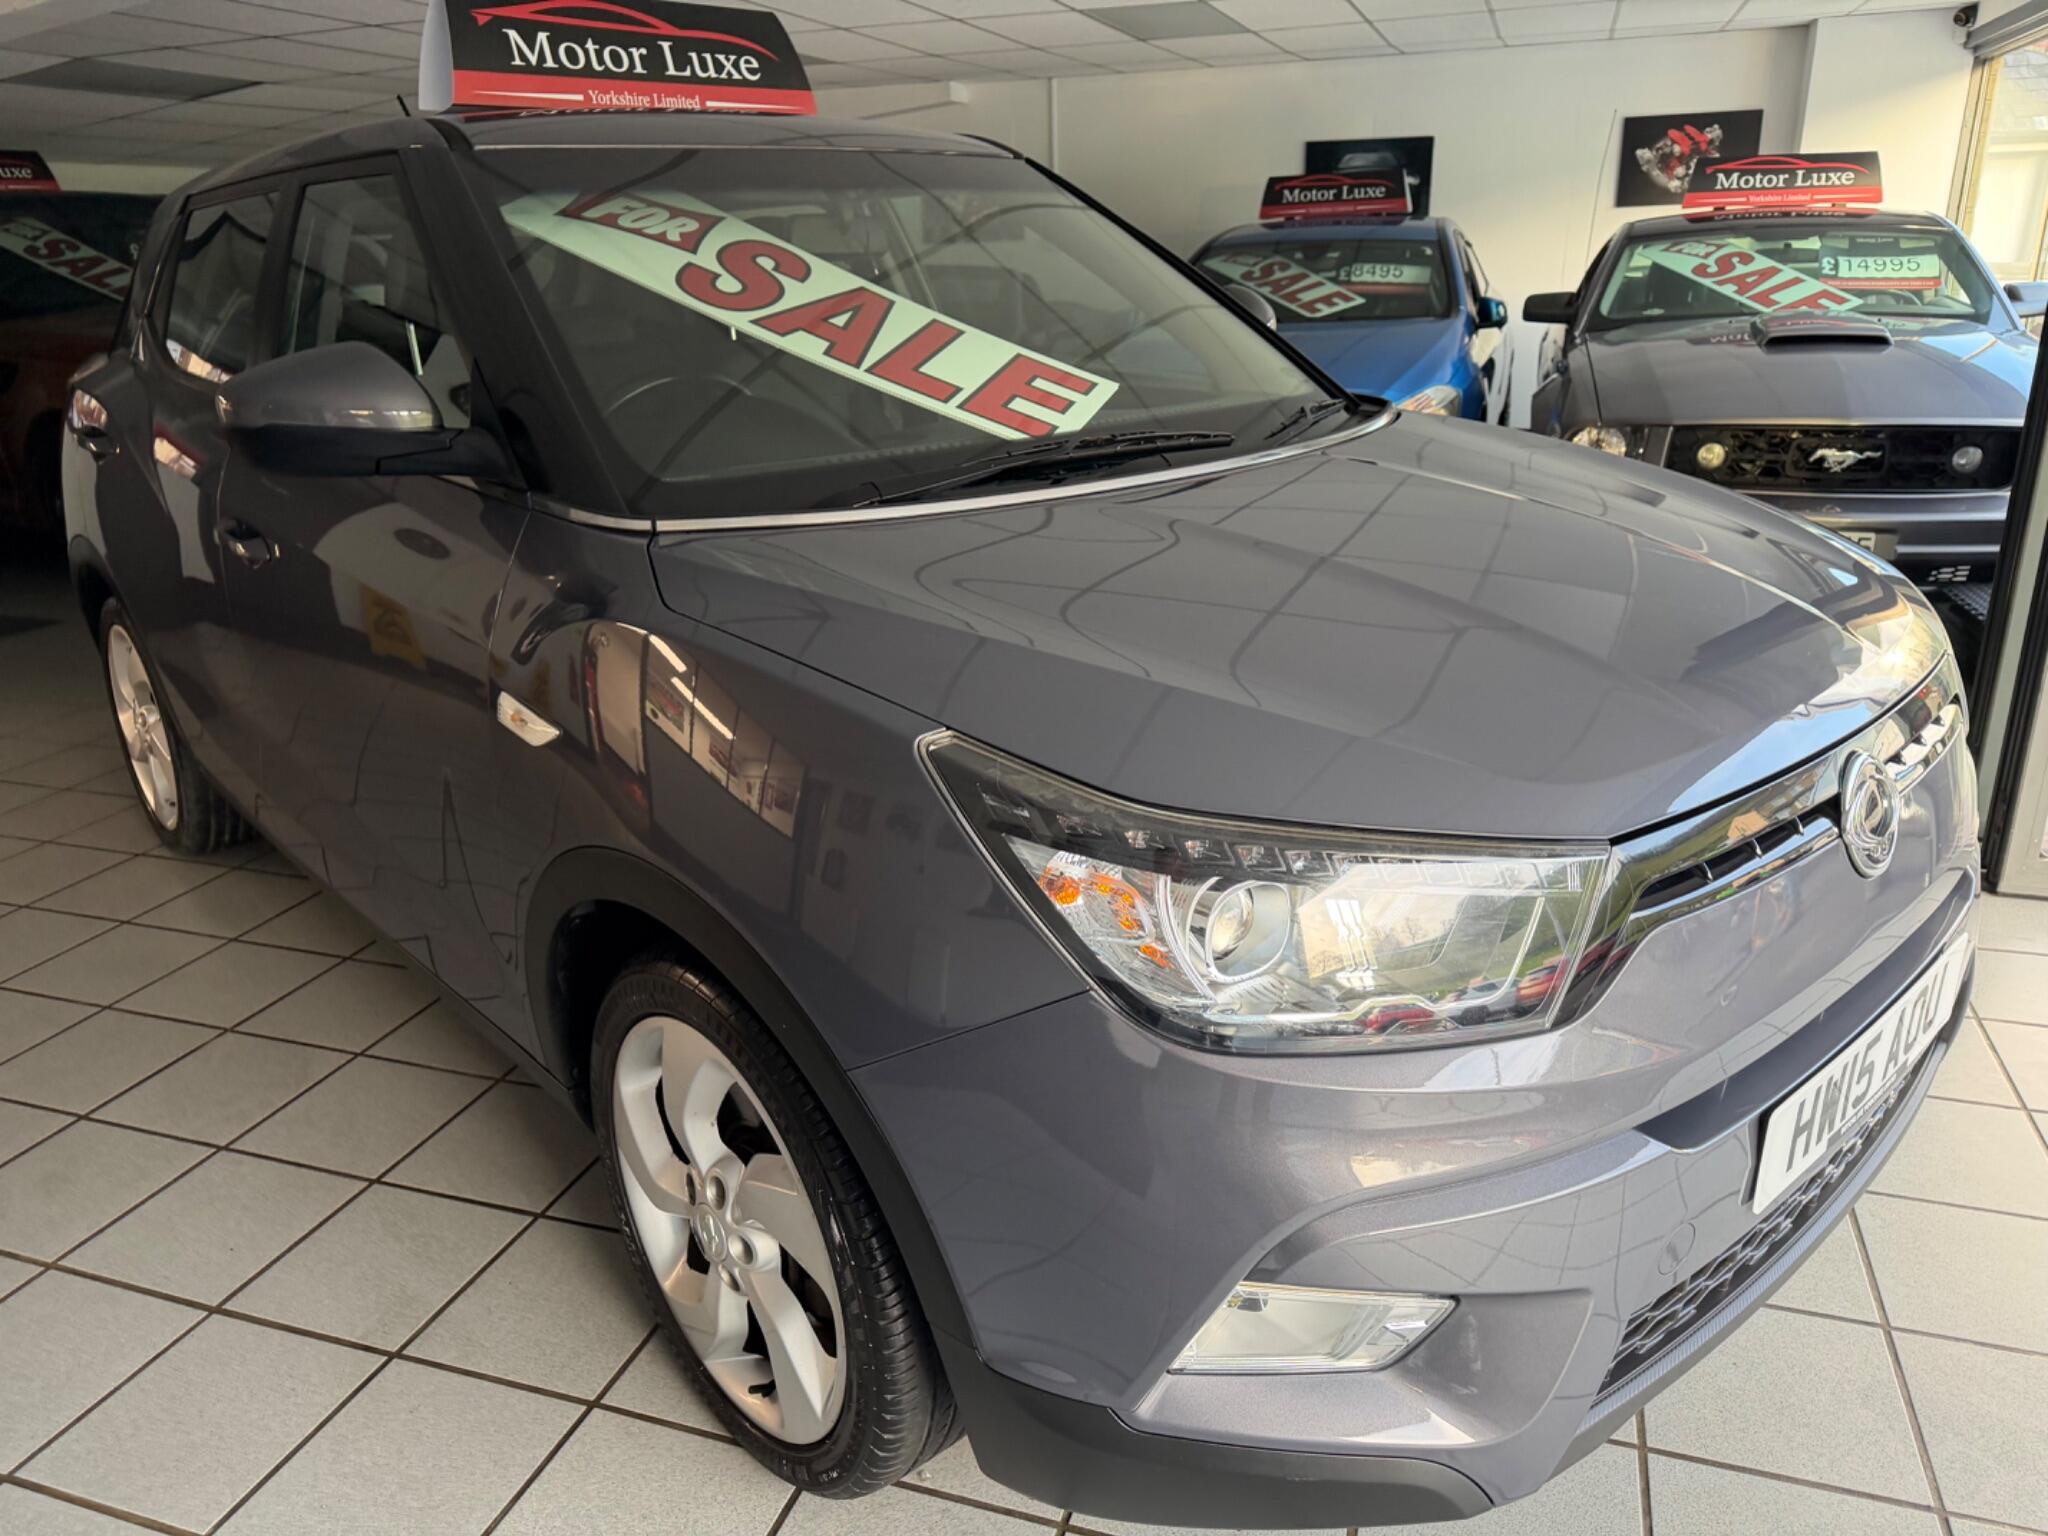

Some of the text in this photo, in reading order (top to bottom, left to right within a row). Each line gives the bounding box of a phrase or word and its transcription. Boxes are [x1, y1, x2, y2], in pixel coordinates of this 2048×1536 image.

[502, 28, 762, 82] Motor Luxe
[588, 89, 701, 110] Yorkshire Limited
[1281, 185, 1386, 204] Motor Luxe
[1714, 169, 1855, 190] Motor Luxe
[1239, 259, 1355, 317] SALE
[580, 197, 1099, 440] FOR SALE
[1786, 1029, 1883, 1174] HW15
